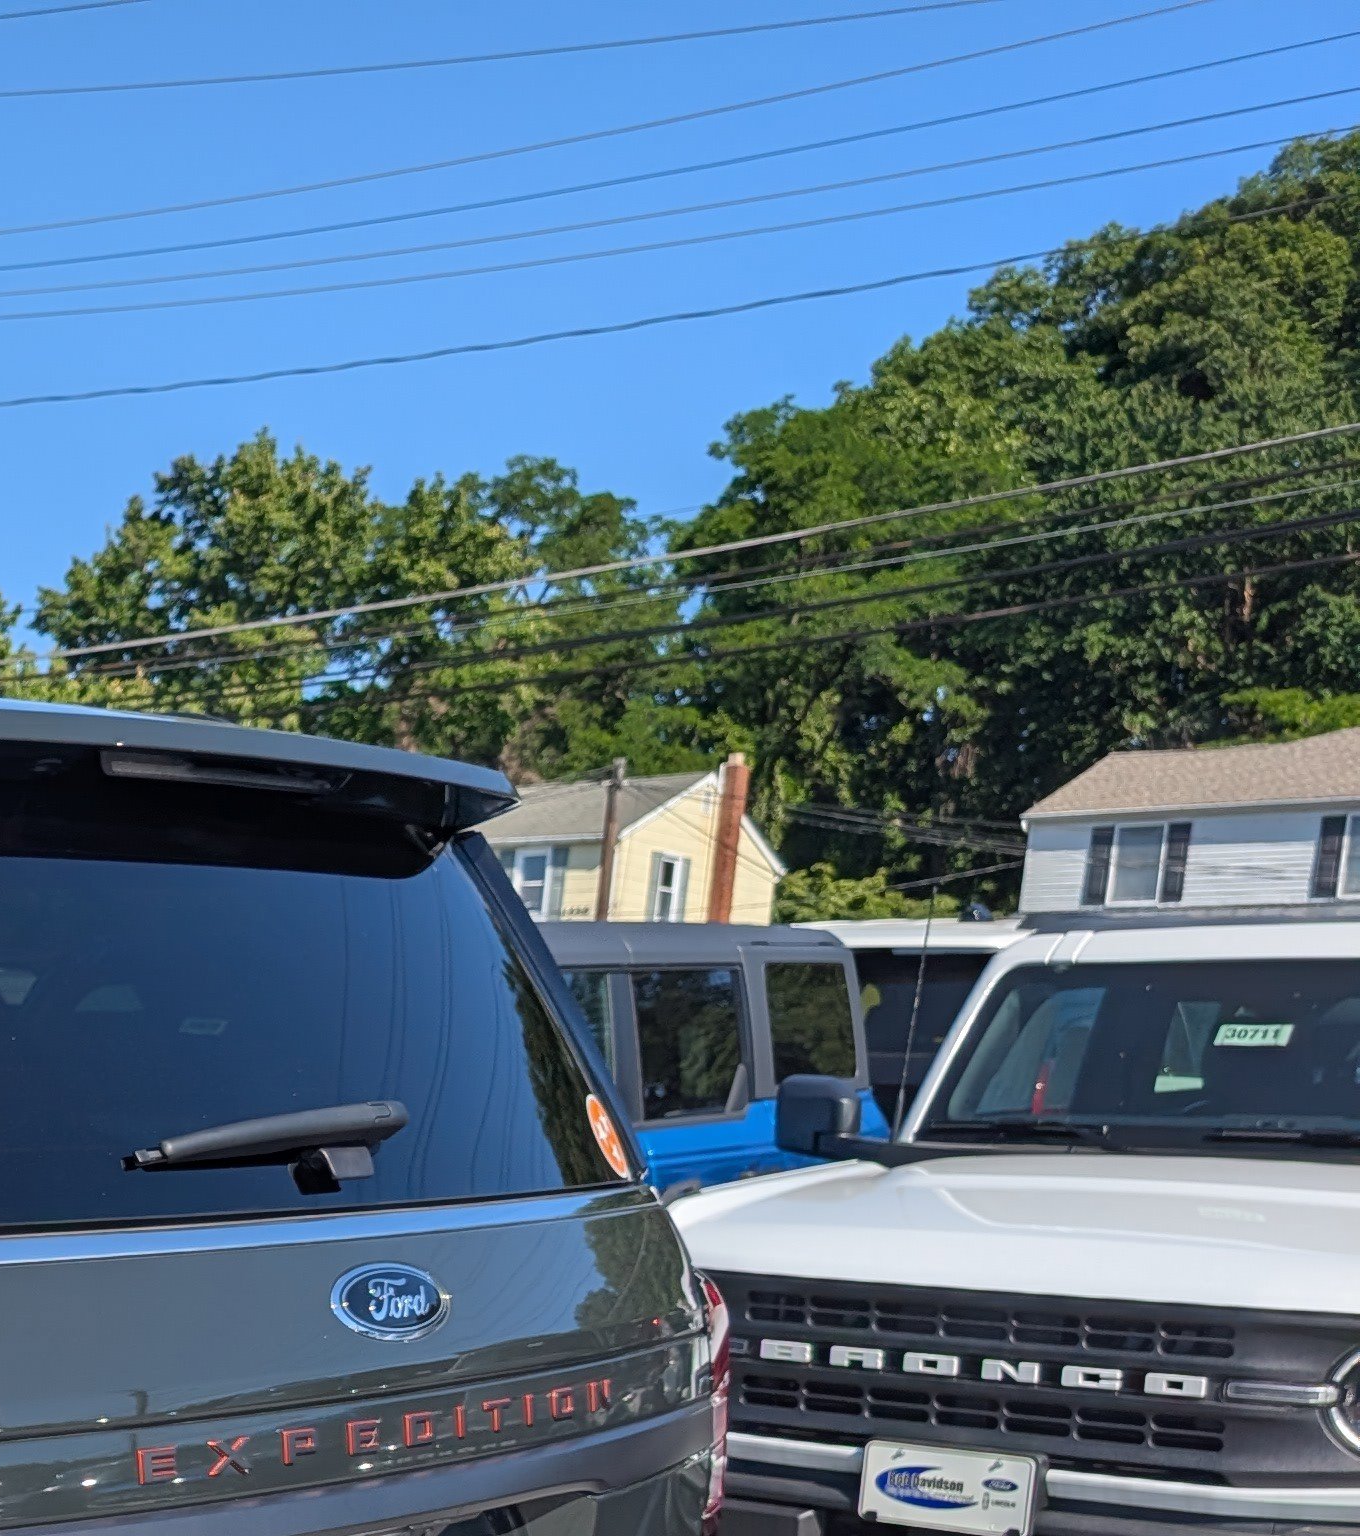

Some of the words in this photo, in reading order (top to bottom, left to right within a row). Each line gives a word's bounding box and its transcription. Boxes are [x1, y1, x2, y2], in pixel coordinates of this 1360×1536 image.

[367, 1277, 430, 1321] Ford
[759, 1338, 1209, 1399] BRONCO
[135, 1378, 613, 1487] EXPEDITION
[887, 1470, 911, 1489] Bob
[911, 1473, 964, 1494] Davidson
